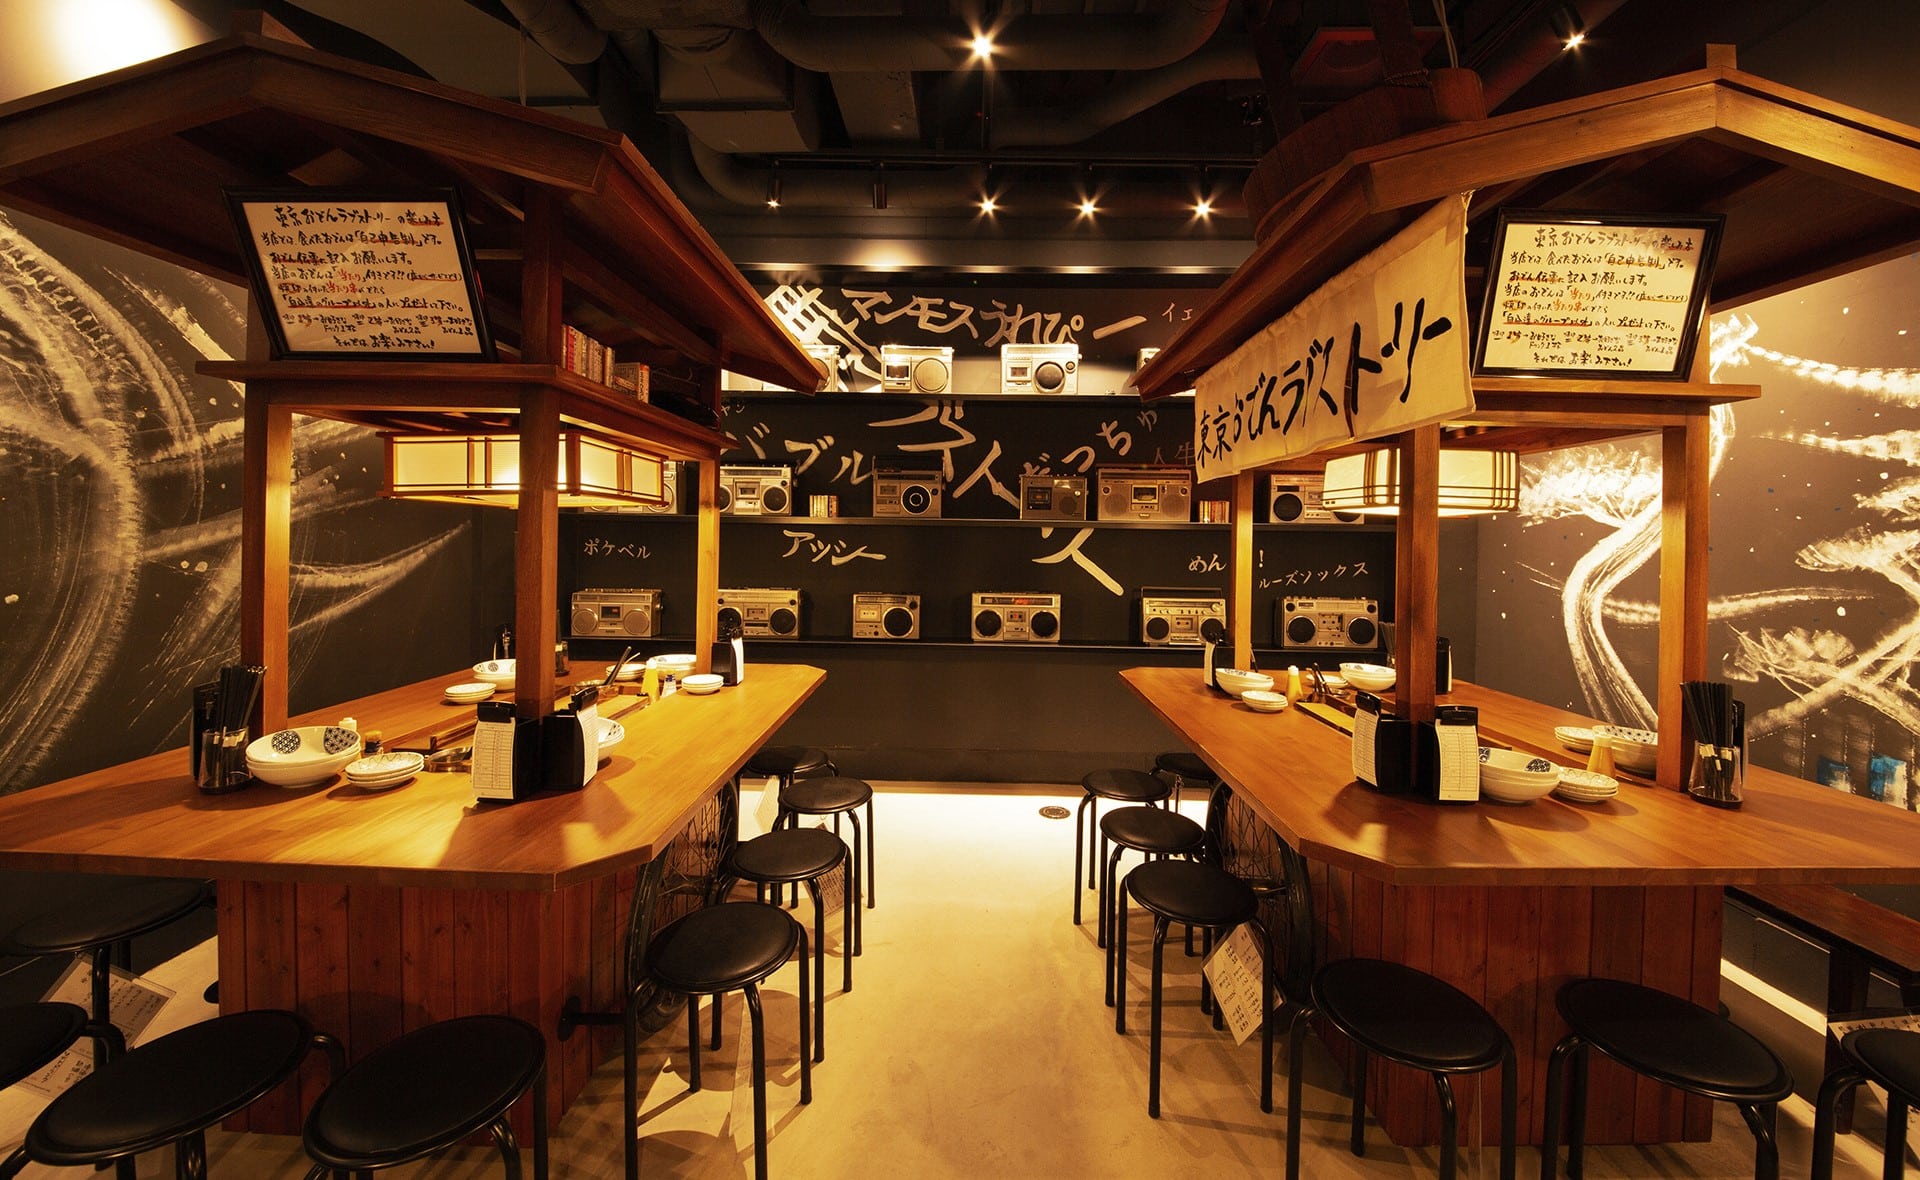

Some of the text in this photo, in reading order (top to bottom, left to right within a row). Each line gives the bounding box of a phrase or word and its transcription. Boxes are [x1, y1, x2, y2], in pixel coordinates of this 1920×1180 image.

[583, 538, 651, 560] ポケベル
[1258, 561, 1369, 590] ルーズソックス
